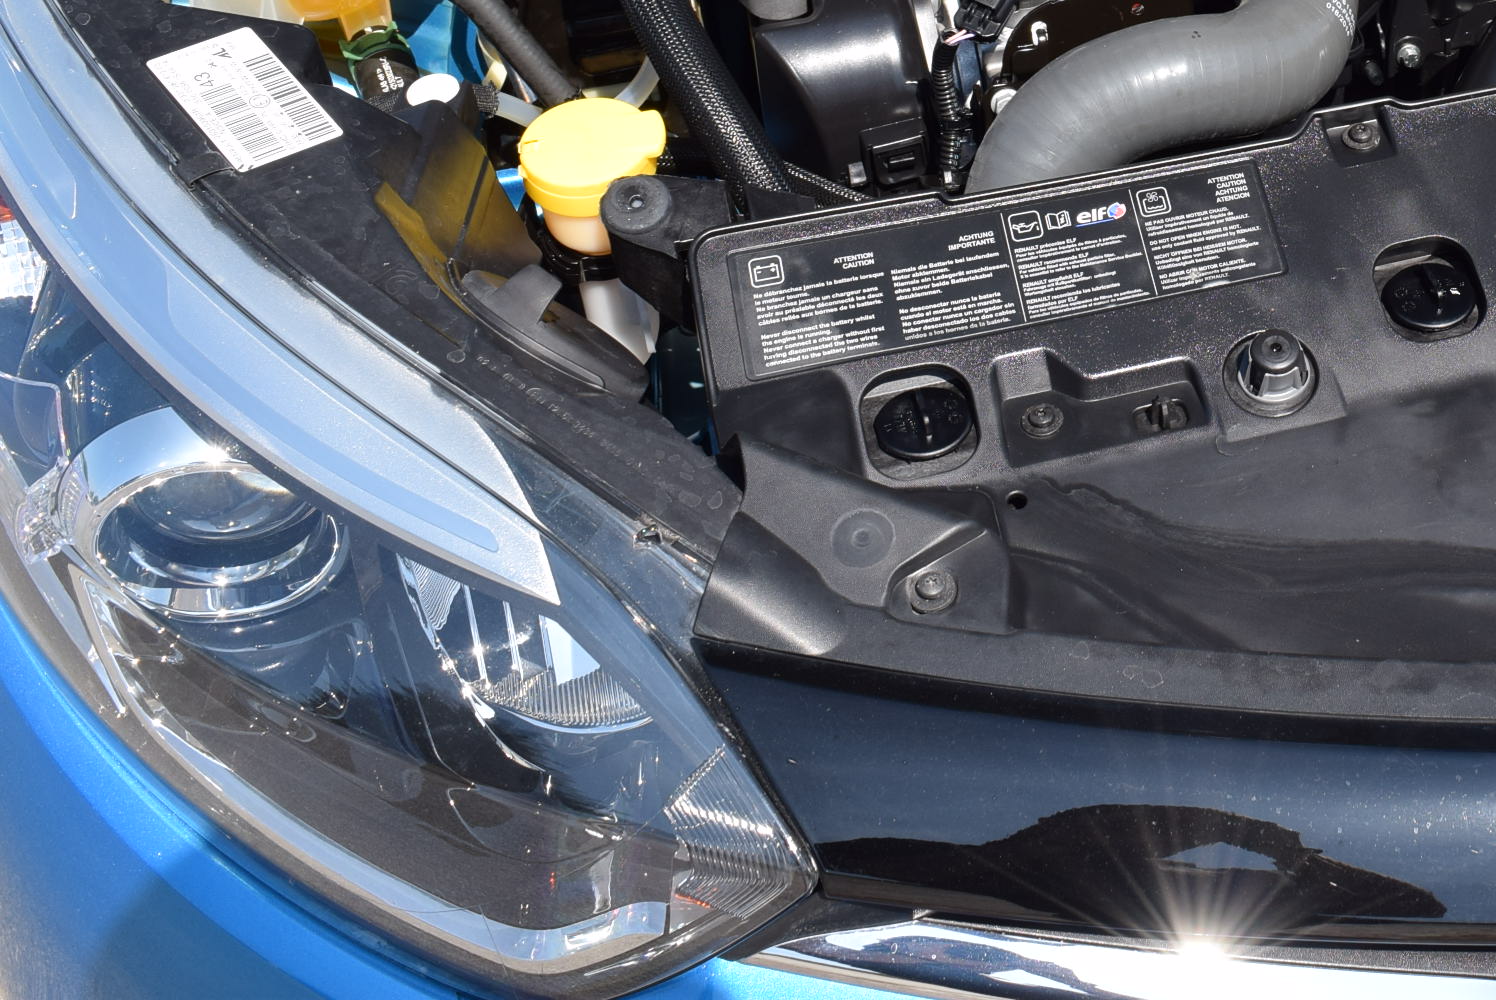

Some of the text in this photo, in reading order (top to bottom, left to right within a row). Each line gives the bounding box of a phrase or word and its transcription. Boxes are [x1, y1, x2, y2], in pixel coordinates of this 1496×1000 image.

[193, 71, 214, 88] 43
[1206, 172, 1244, 183] ATTENTION
[1216, 179, 1246, 188] CAUTION
[1214, 185, 1248, 195] ACHTUNG
[1216, 192, 1250, 202] ATENCION
[1075, 206, 1108, 222] elf
[958, 231, 993, 242] ACHTUNG
[948, 237, 995, 251] IMPORTANTE
[833, 252, 874, 264] ATTENTION
[842, 258, 874, 269] CAUTION
